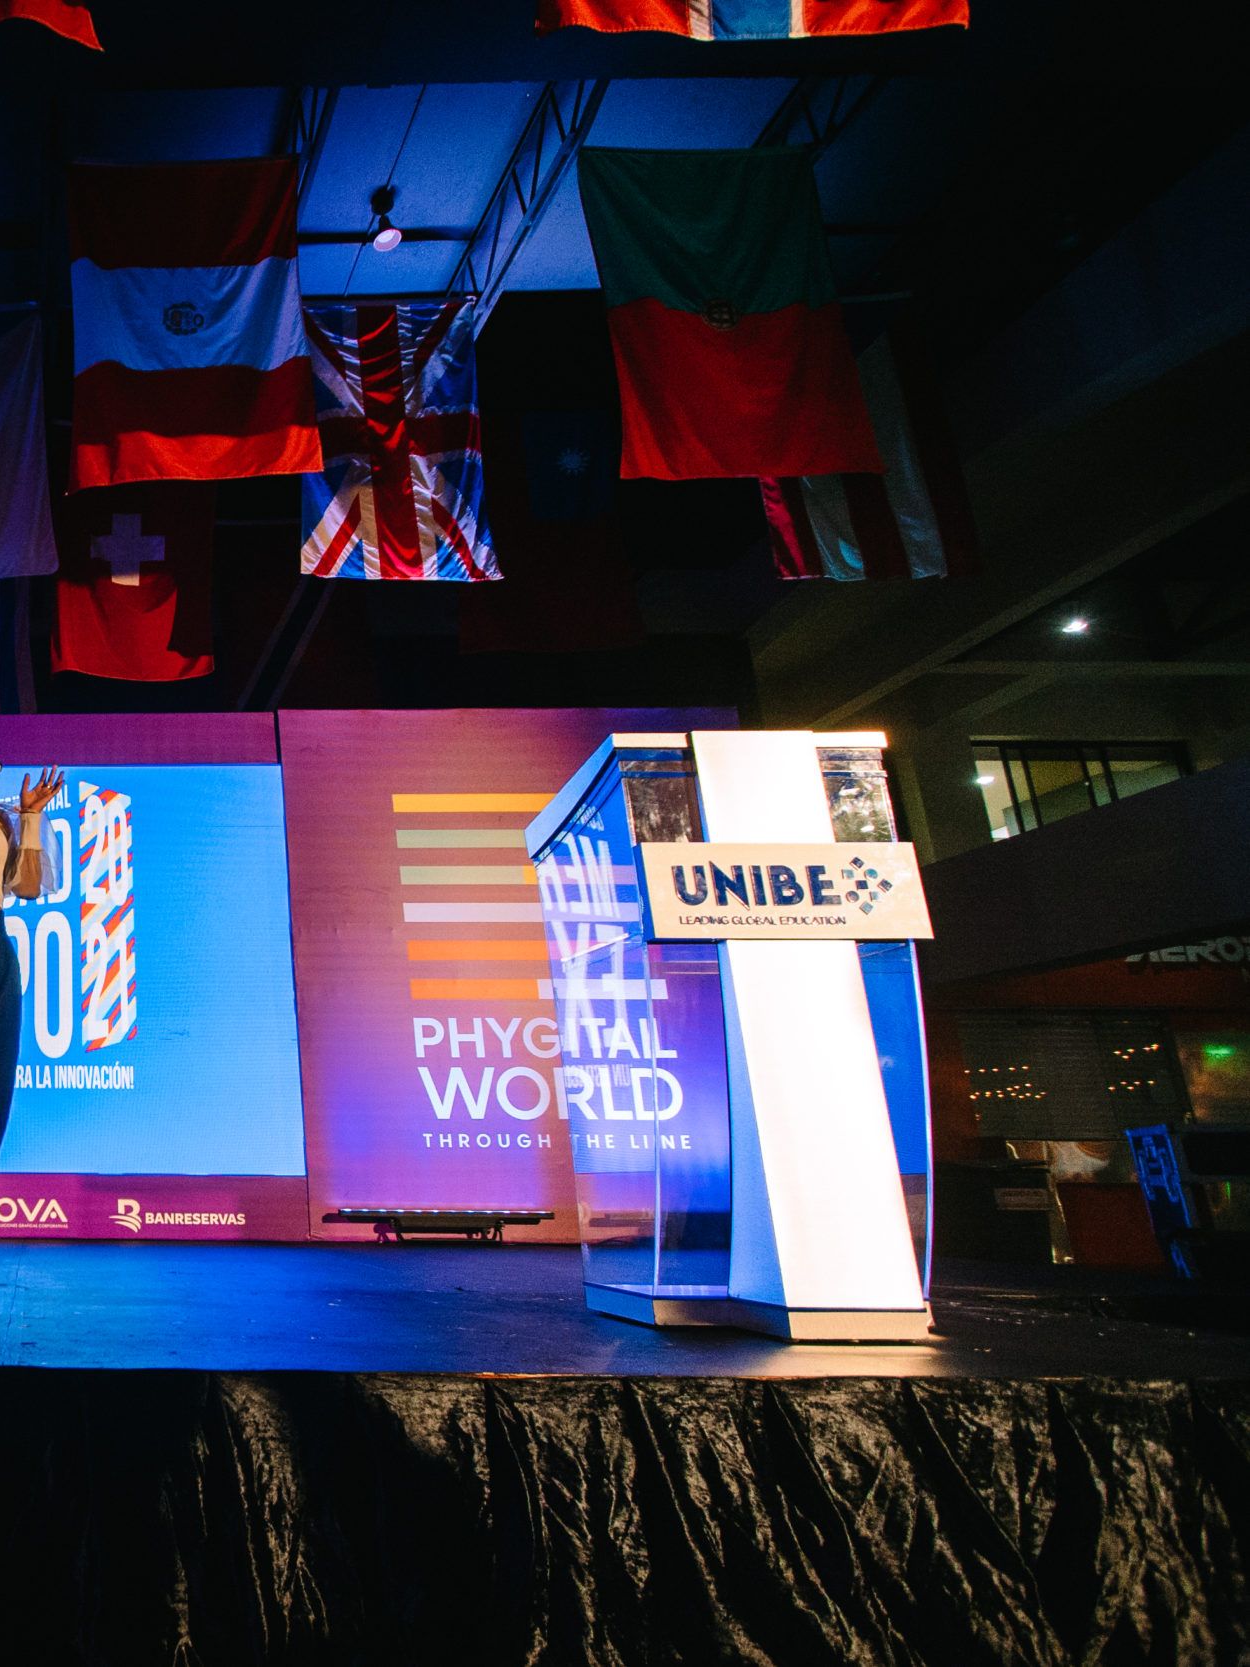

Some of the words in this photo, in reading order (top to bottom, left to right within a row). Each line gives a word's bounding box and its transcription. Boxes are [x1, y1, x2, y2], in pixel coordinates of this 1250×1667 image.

[671, 860, 843, 911] UNIBE
[679, 915, 730, 925] LEADING
[732, 915, 777, 925] GLOBAL
[780, 915, 846, 925] EDUCATION
[412, 1017, 678, 1059] PHYGITAL
[14, 1065, 32, 1089] RA
[35, 1065, 52, 1089] LA
[54, 1061, 135, 1089] INNOVACIÓN!
[417, 1066, 684, 1121] WORLD
[423, 1133, 551, 1149] THROUGH
[569, 1134, 615, 1149] THE
[630, 1134, 692, 1150] LINE
[145, 1212, 246, 1225] BANRESERVAS
